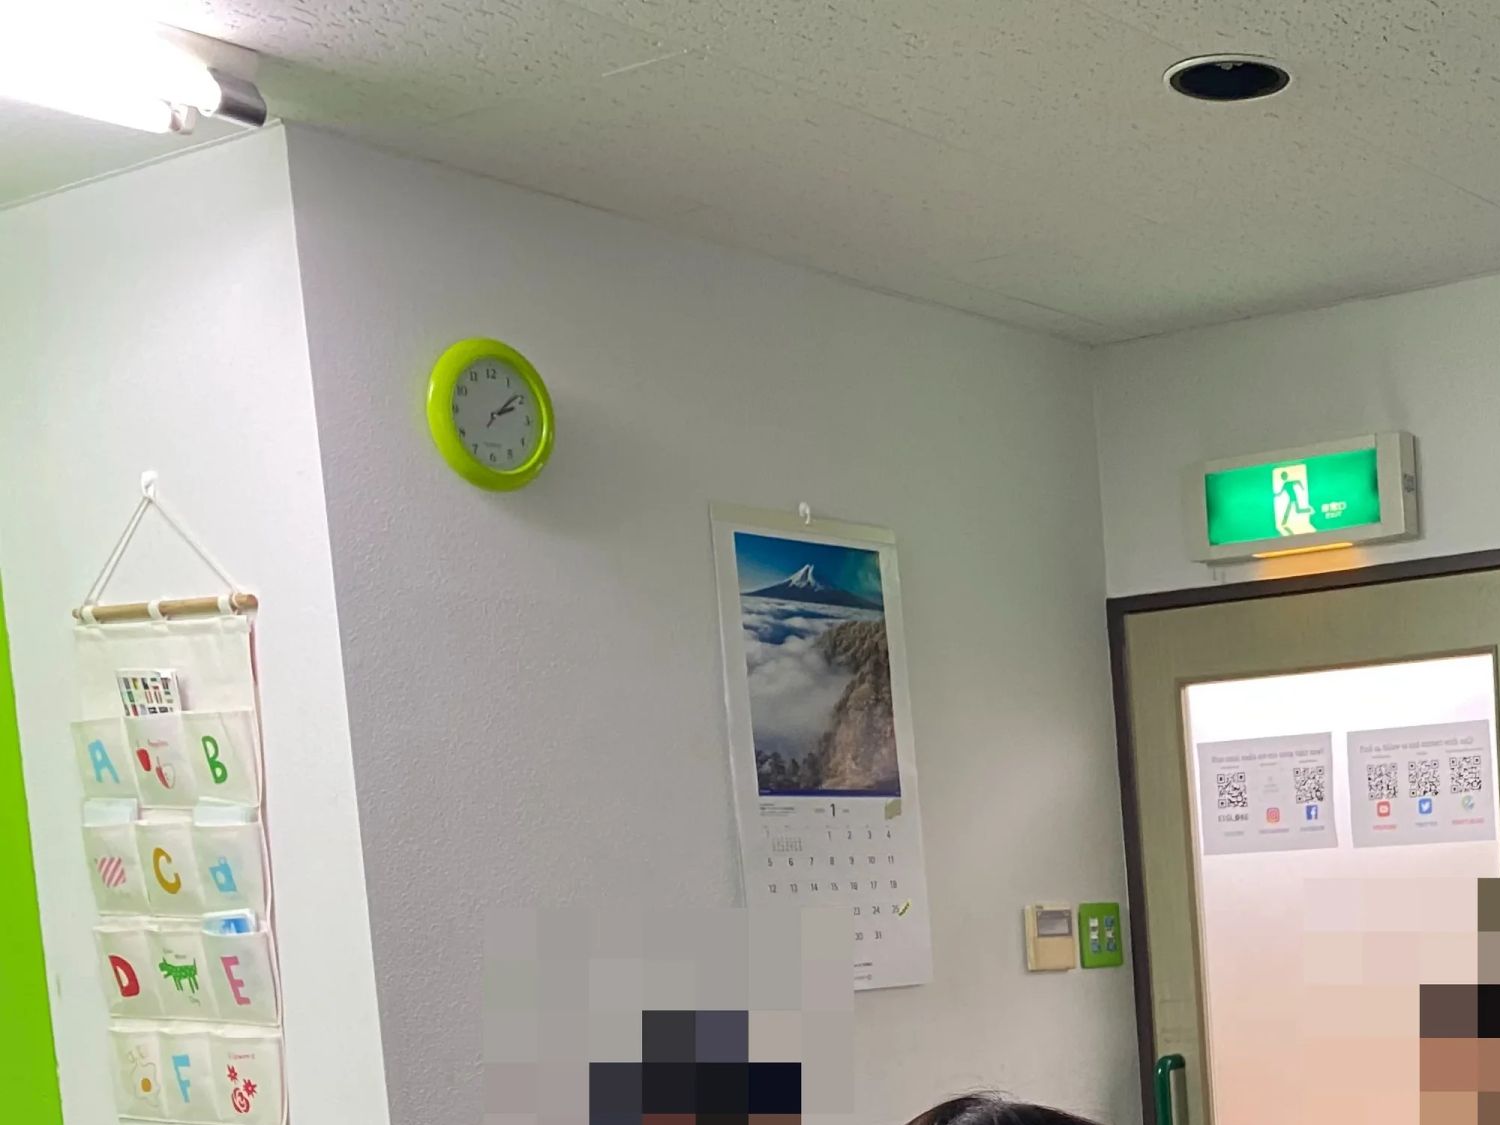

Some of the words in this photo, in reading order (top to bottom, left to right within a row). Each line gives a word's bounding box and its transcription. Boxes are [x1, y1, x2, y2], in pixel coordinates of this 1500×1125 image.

[470, 371, 478, 382] 11
[486, 368, 496, 379] 12
[457, 385, 468, 396] 10
[472, 443, 479, 454] 7
[489, 453, 496, 462] 6
[87, 739, 120, 784] A
[201, 735, 228, 784] B
[830, 803, 836, 817] 1
[886, 830, 891, 839] 4
[767, 857, 773, 867] 5
[788, 857, 794, 866] 6
[809, 856, 814, 865] 7
[868, 856, 876, 864] 10
[887, 855, 894, 864] 11
[152, 847, 182, 894] C
[768, 884, 777, 893] 12
[790, 883, 798, 893] 13
[810, 882, 818, 892] 14
[830, 882, 839, 891] 15
[870, 880, 878, 889] 17
[889, 880, 898, 889] 18
[872, 906, 881, 915] 24
[855, 931, 864, 941] 30
[875, 930, 883, 940] 31
[108, 954, 140, 998] D
[219, 955, 251, 1006] E
[171, 1054, 191, 1104] F
